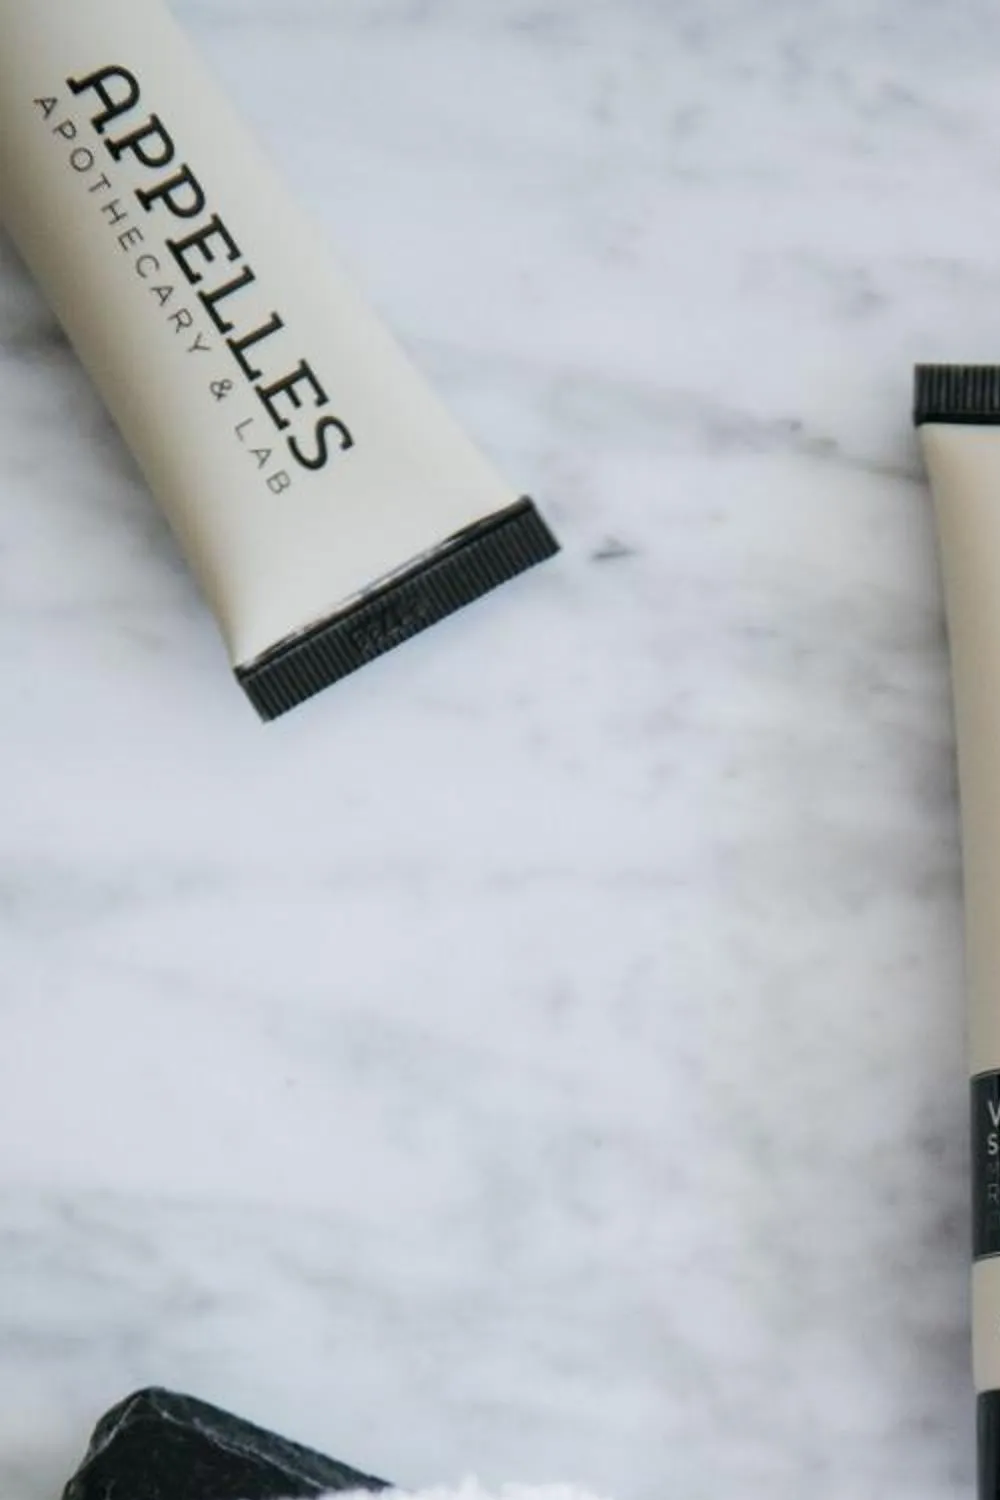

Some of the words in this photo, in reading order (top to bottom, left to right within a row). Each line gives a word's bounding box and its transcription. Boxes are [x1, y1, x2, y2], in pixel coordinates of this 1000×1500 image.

[33, 94, 212, 359] APOTHECARY
[209, 377, 235, 402] &
[234, 417, 292, 496] LAB
[66, 63, 355, 472] APPELLES
